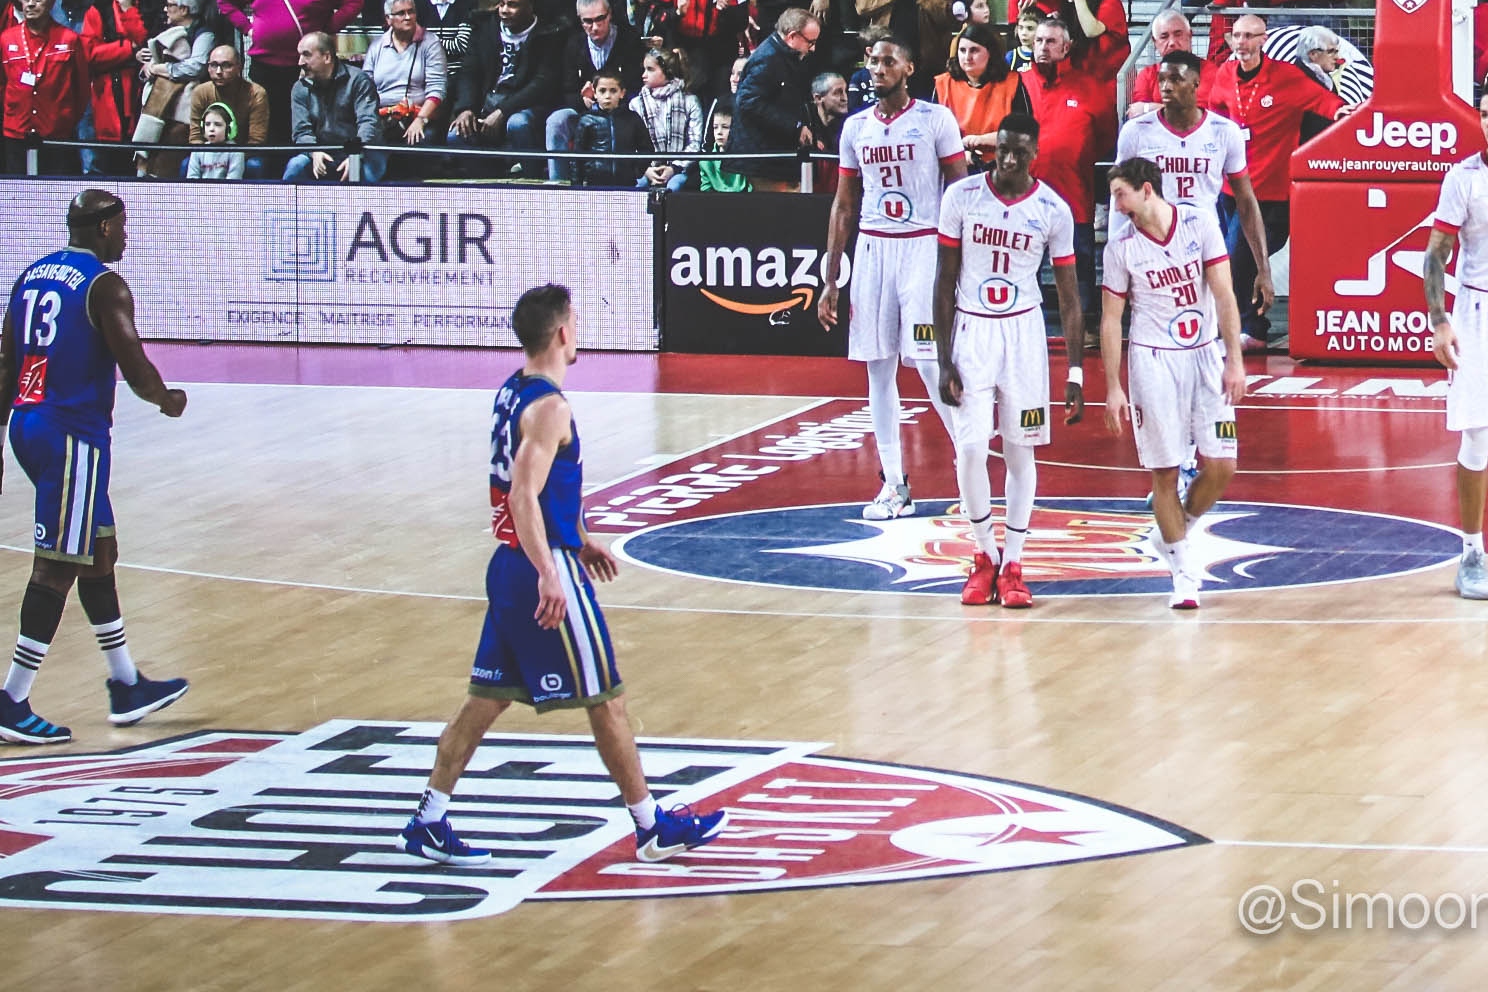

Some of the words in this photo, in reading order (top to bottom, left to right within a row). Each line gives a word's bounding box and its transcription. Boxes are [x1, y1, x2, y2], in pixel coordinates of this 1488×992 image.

[1356, 112, 1457, 155] Jeep
[862, 144, 915, 164] CHOLET
[1155, 155, 1211, 174] CHOLET
[879, 165, 904, 188] 21
[1176, 176, 1195, 198] 12
[885, 201, 904, 218] U
[346, 211, 495, 265] AGIR
[972, 223, 1033, 251] CHOLET
[990, 250, 1010, 274] 11
[345, 269, 495, 286] RECOUVREMENT
[1146, 259, 1201, 289] CHOLET
[987, 287, 1009, 304] U
[1171, 282, 1198, 307] 20
[22, 288, 62, 347] 13
[227, 311, 305, 325] EXIGENCE
[1178, 319, 1198, 339] U
[1316, 311, 1381, 335] JEAN
